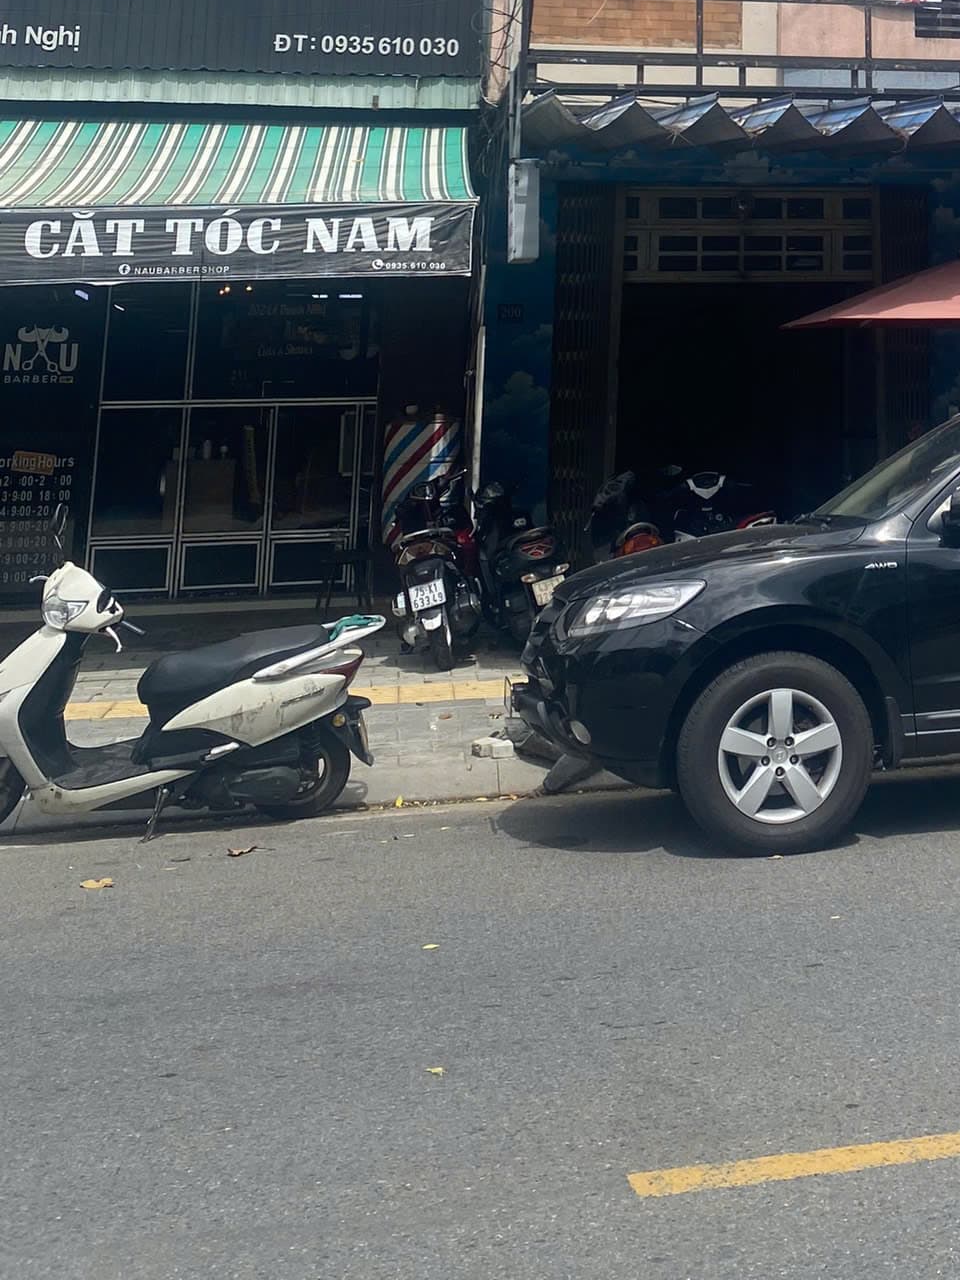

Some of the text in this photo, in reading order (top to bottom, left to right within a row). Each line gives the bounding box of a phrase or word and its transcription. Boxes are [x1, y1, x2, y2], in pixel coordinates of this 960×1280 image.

[25, 25, 81, 52] Nghị
[165, 208, 282, 256] TÓC
[303, 216, 435, 253] NAM
[4, 375, 57, 384] BARBER
